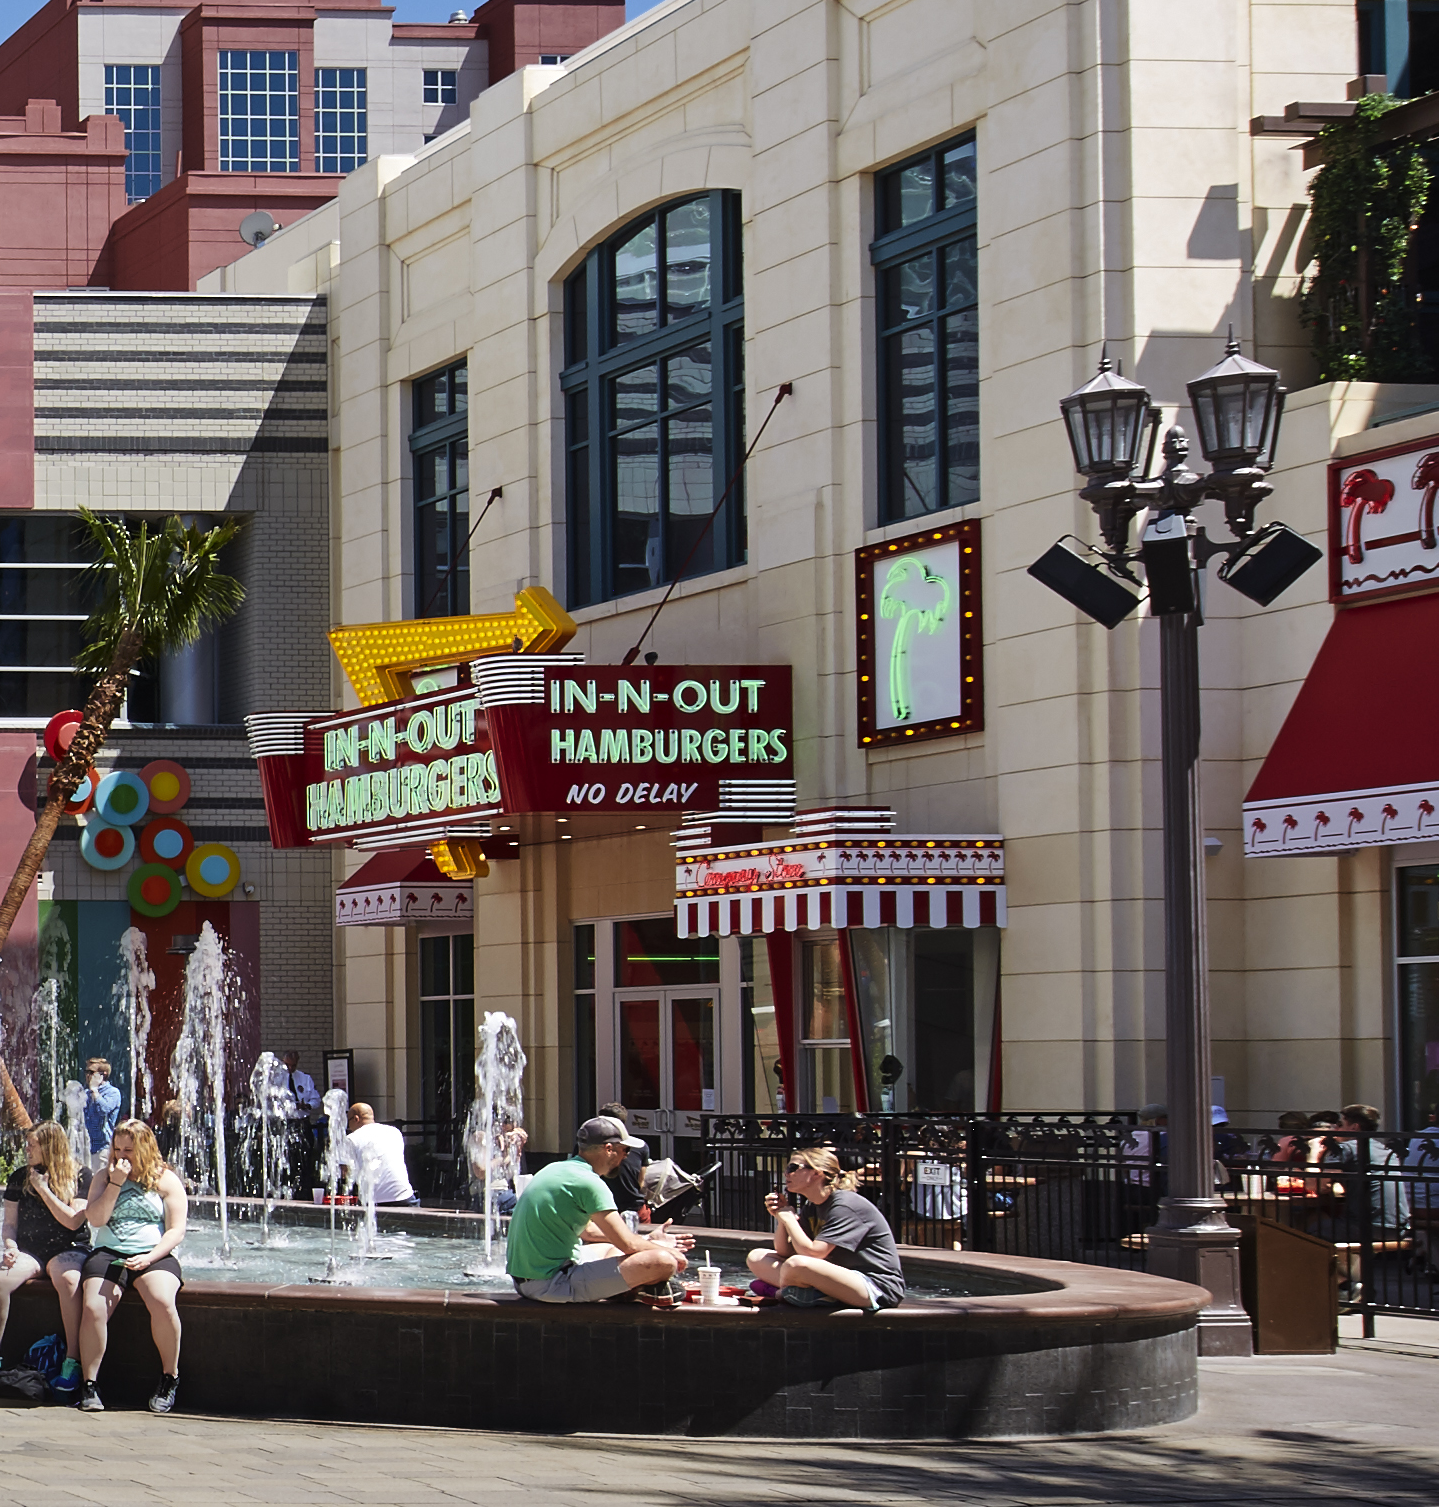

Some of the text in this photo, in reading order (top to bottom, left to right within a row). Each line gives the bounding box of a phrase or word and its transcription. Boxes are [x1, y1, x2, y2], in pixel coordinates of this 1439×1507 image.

[550, 679, 766, 714] IN-N-OUT
[323, 698, 481, 772] IN-N-OUT
[550, 728, 788, 764] HAMBURGERS
[305, 750, 502, 832] HAMBURGERS
[566, 782, 699, 805] NO DELAY
[695, 853, 806, 892] Company Store
[923, 1166, 941, 1176] EXIT
